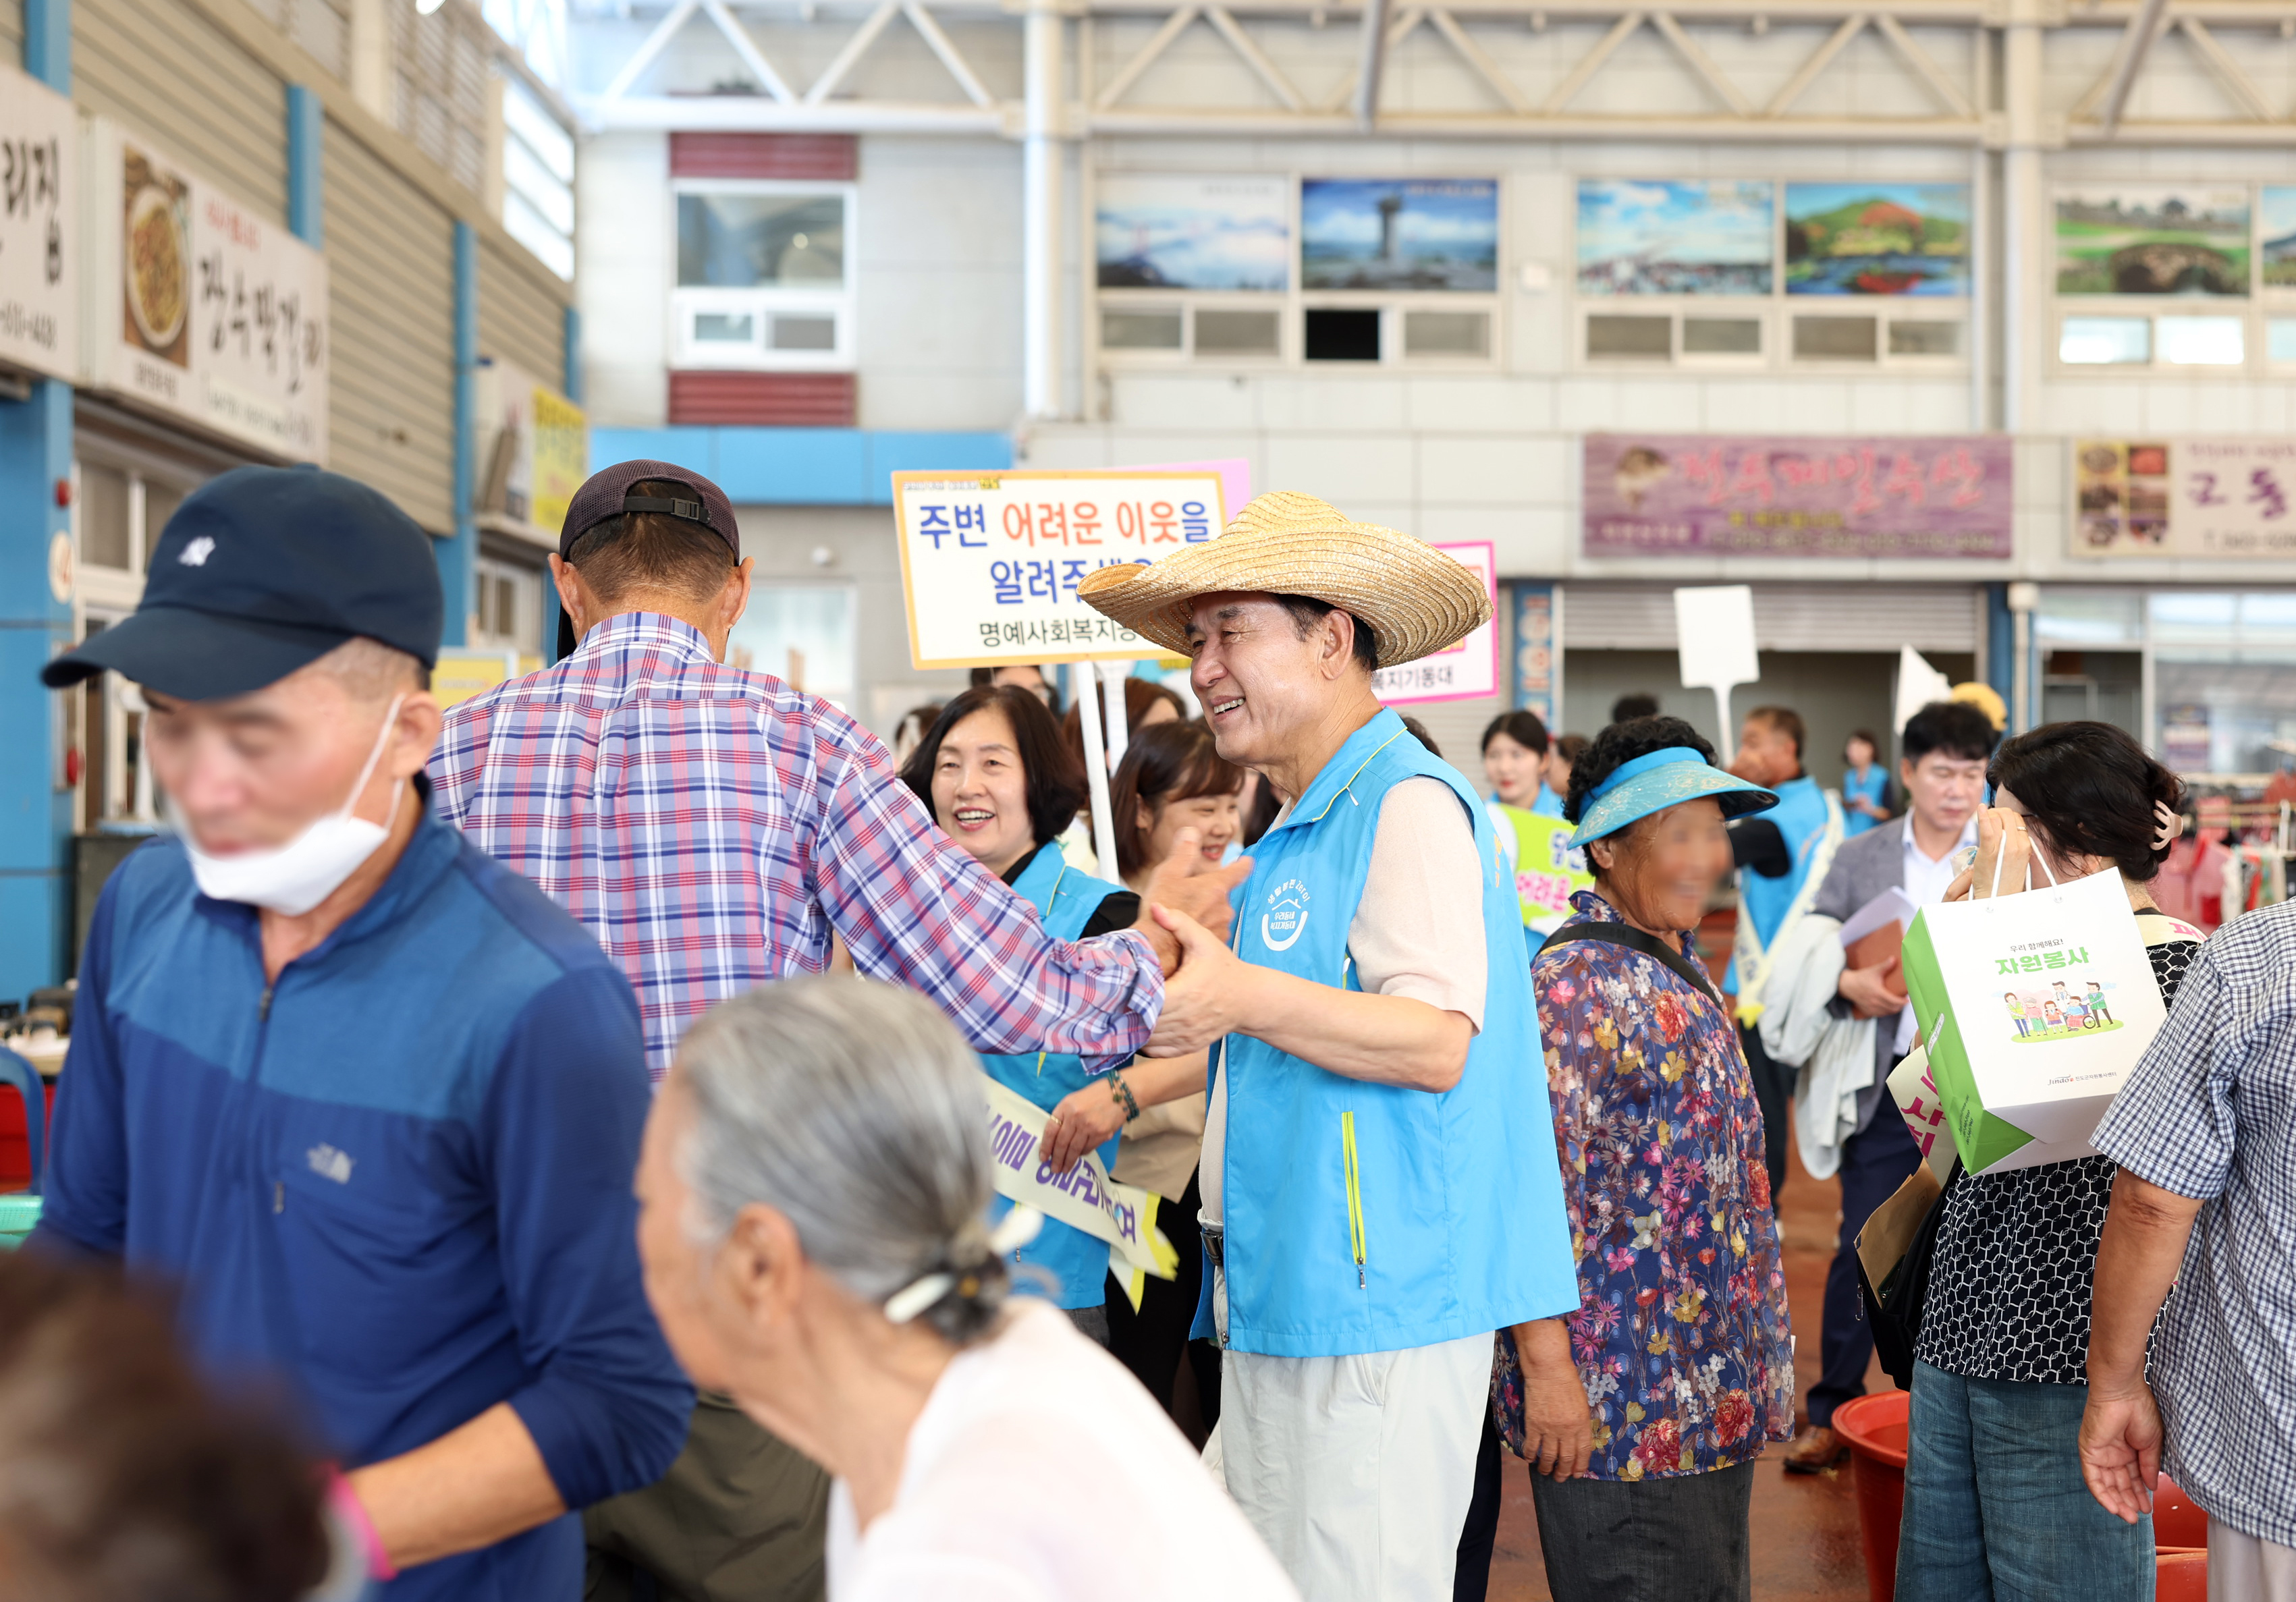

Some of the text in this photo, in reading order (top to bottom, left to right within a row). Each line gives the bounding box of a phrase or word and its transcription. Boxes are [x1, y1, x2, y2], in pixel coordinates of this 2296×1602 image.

[920, 501, 1210, 549] 주변 어려운 이웃을
[1274, 911, 1295, 920] 우리동네
[2027, 939, 2064, 951] 함께해요!
[1994, 946, 2089, 975] 자원봉사
